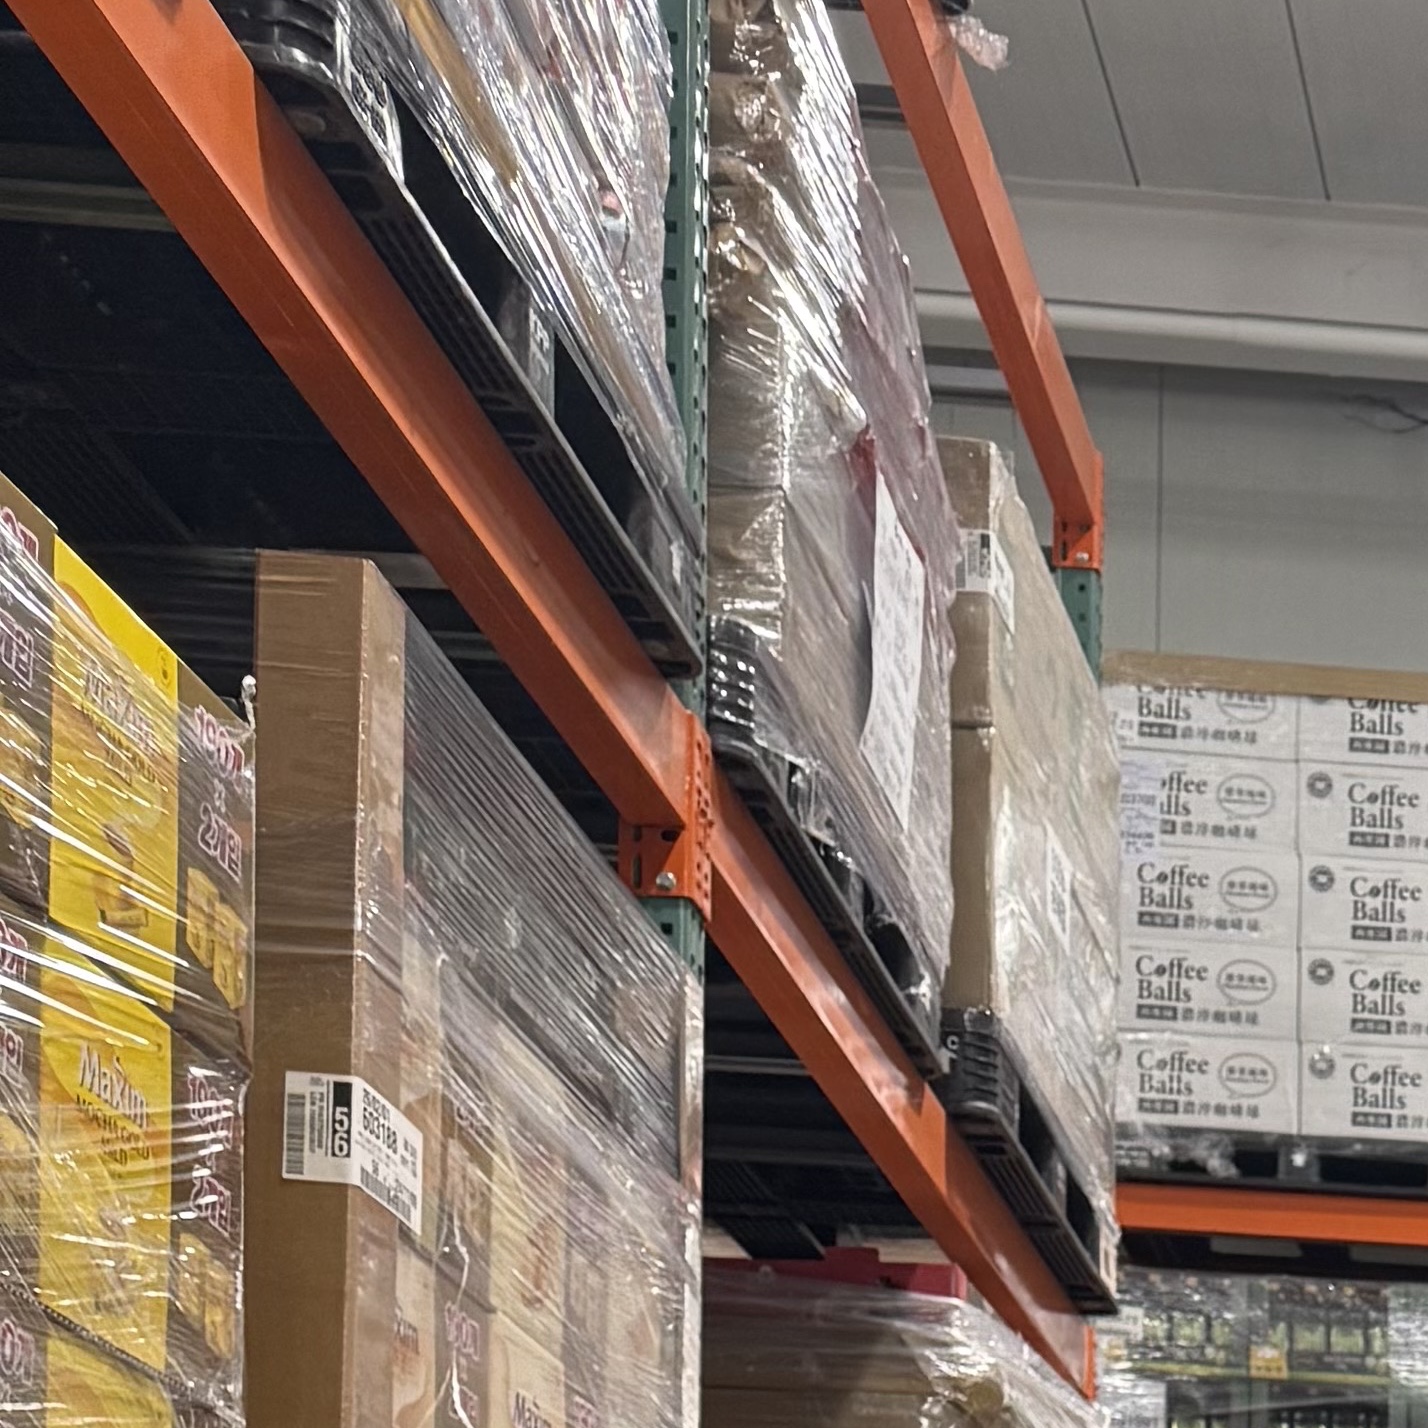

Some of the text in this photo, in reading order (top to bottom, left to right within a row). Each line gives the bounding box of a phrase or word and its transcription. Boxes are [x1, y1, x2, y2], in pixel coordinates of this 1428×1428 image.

[1138, 696, 1192, 721] Balls
[1349, 712, 1404, 736] Balls
[1347, 782, 1420, 808] Coffee
[1350, 806, 1404, 830] Balls
[1137, 861, 1210, 888] Coffee
[1139, 886, 1194, 911] Balls
[1350, 876, 1422, 902] Coffee
[1352, 899, 1406, 924] Balls
[1136, 955, 1210, 981] Coffee
[1137, 978, 1193, 1003] Balls
[1349, 969, 1422, 995] Coffee
[1352, 992, 1406, 1017] Balls
[1136, 1049, 1210, 1075] Coffee
[79, 1042, 148, 1130] Maxim
[1138, 1072, 1194, 1096] Balls
[1350, 1062, 1423, 1088] Coffee
[1352, 1086, 1407, 1110] Balls
